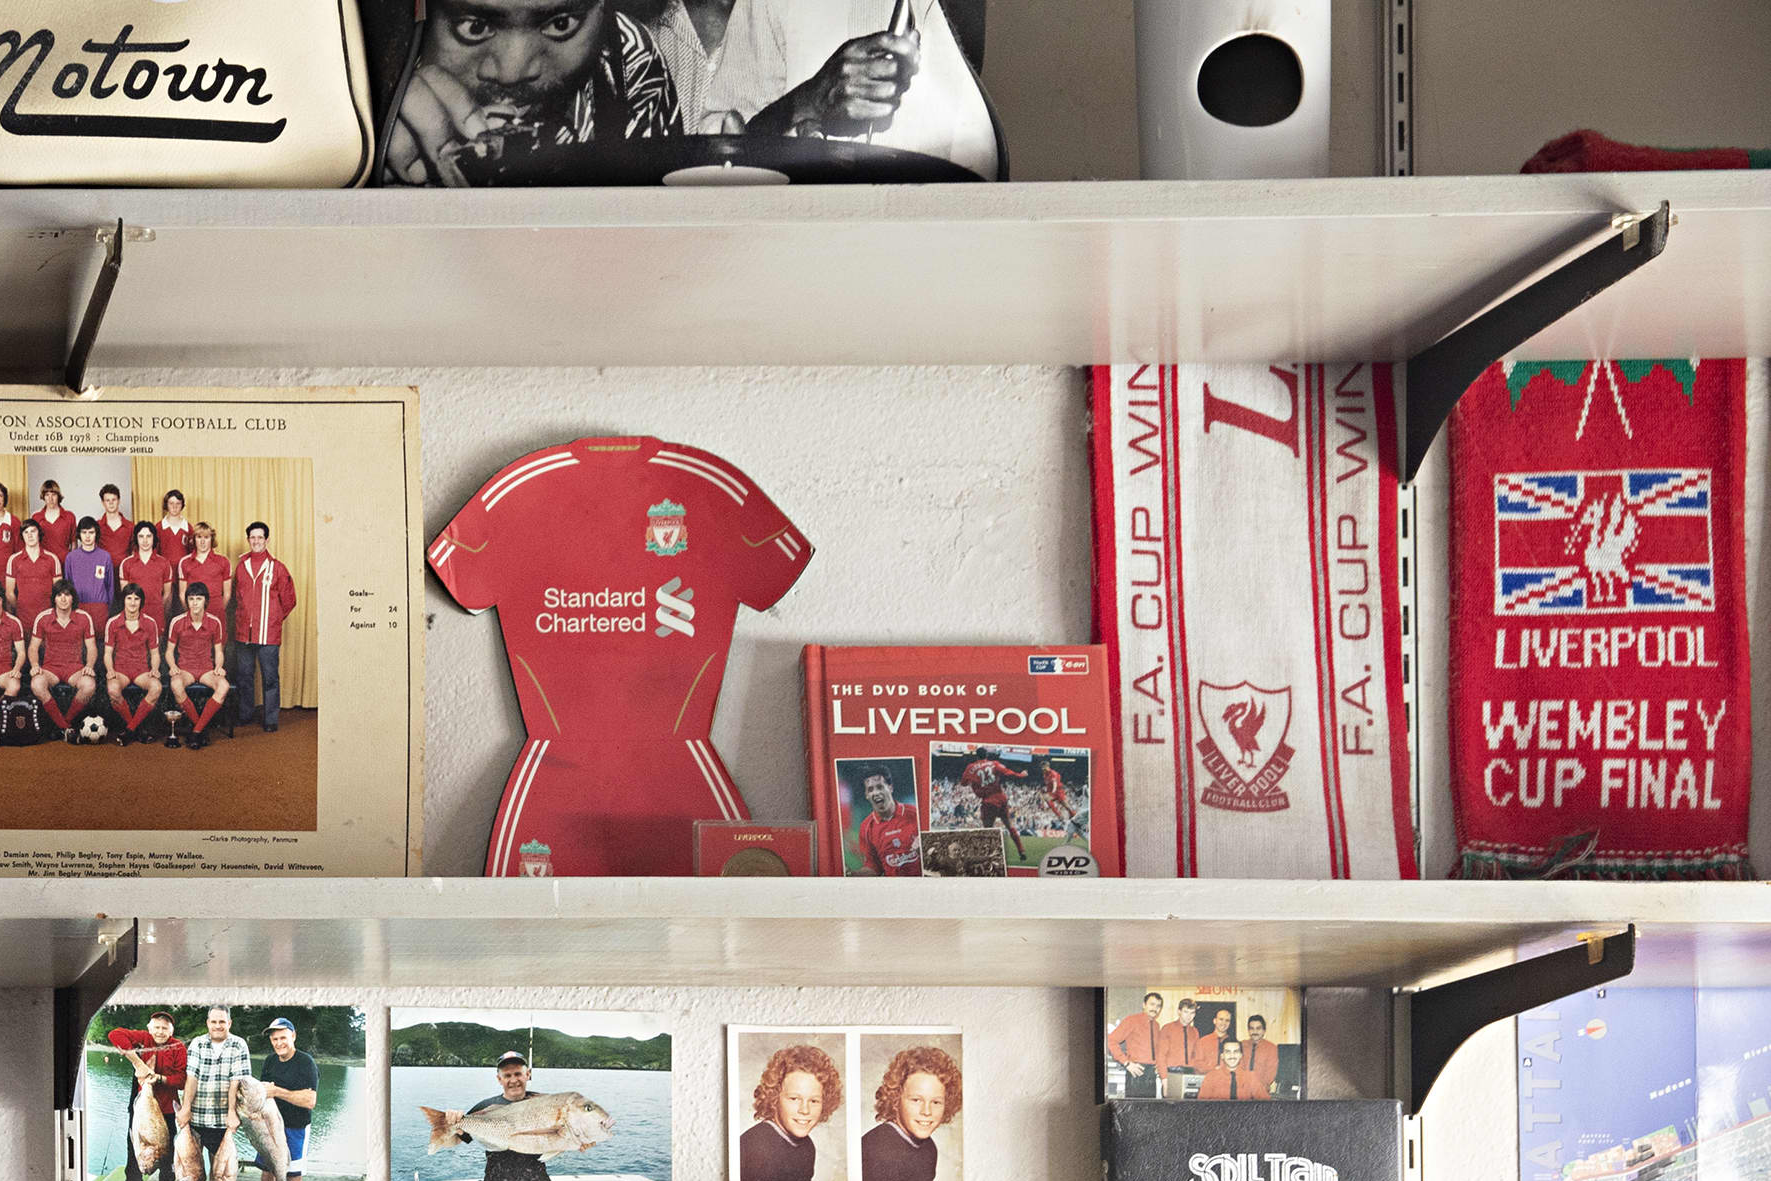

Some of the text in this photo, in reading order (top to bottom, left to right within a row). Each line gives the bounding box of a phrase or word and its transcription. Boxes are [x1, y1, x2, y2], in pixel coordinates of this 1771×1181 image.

[35, 415, 143, 429] ASSOCIATION
[152, 416, 237, 430] FOOTBALL
[244, 418, 288, 431] CLUB
[9, 431, 160, 444] Under 16B 1978 Champions
[13, 444, 154, 454] WINNERS CLUB CHAMPIONSHIP SHIELD
[543, 587, 646, 608] Standard
[350, 605, 398, 613] For 24
[350, 621, 398, 630] Against 10
[535, 611, 646, 634] Chartered
[1130, 506, 1167, 746] F.A. CUP
[1339, 513, 1374, 757] F.A. CUP
[1495, 628, 1718, 670] LIVERPOOL
[831, 685, 998, 697] THE DVD BOOK OF
[832, 699, 1087, 735] LIVERPOOL
[1482, 699, 1726, 751] WEMBLEY
[1208, 755, 1284, 798] LIVER POOL
[1485, 759, 1722, 810] CUP FINAL
[1046, 855, 1091, 868] DVD
